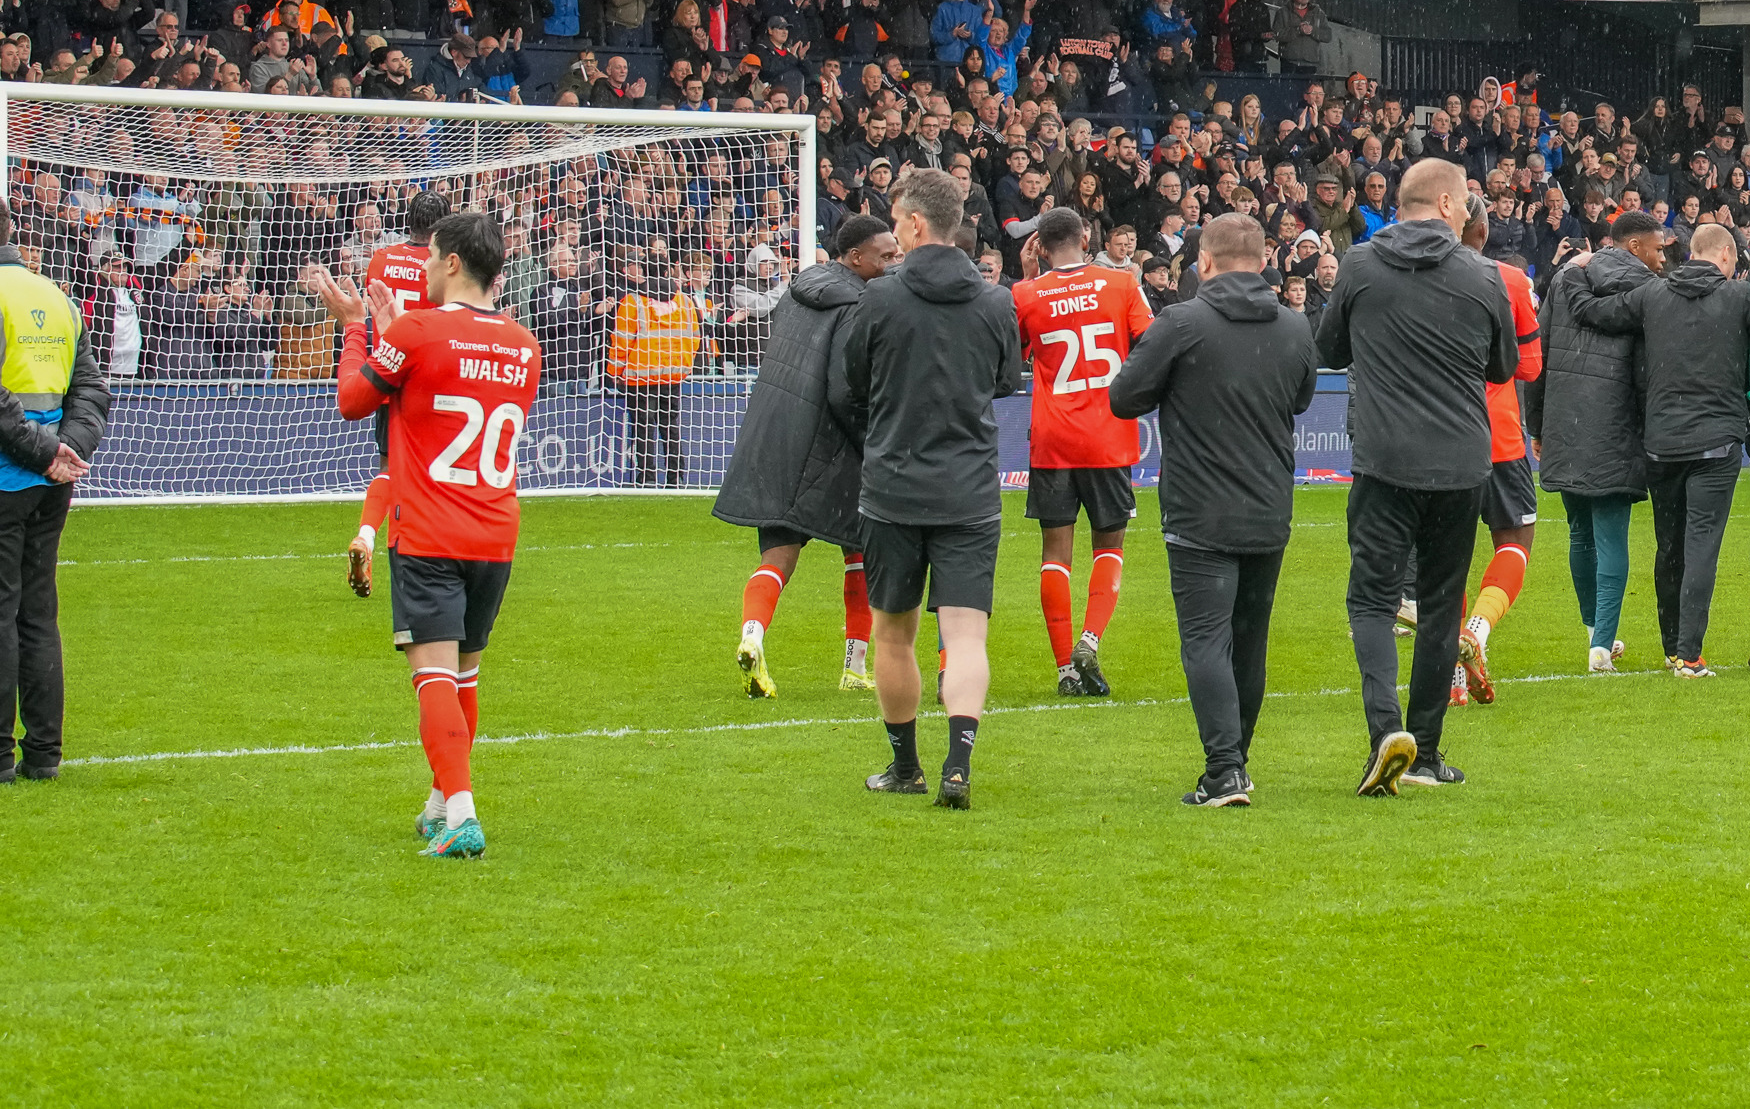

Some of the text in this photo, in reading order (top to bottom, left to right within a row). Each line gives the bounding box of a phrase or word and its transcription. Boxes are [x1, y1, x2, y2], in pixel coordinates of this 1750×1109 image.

[1088, 40, 1113, 51] TOWN
[386, 253, 424, 265] Toureen Group
[384, 265, 421, 281] MENGI
[1037, 281, 1093, 298] Toureen Group
[1049, 294, 1099, 317] JONES
[18, 336, 67, 345] CROWDSAFE
[449, 340, 519, 357] Toureen Group
[1040, 322, 1122, 394] 25
[459, 358, 528, 387] WALSH
[429, 394, 524, 489] 20
